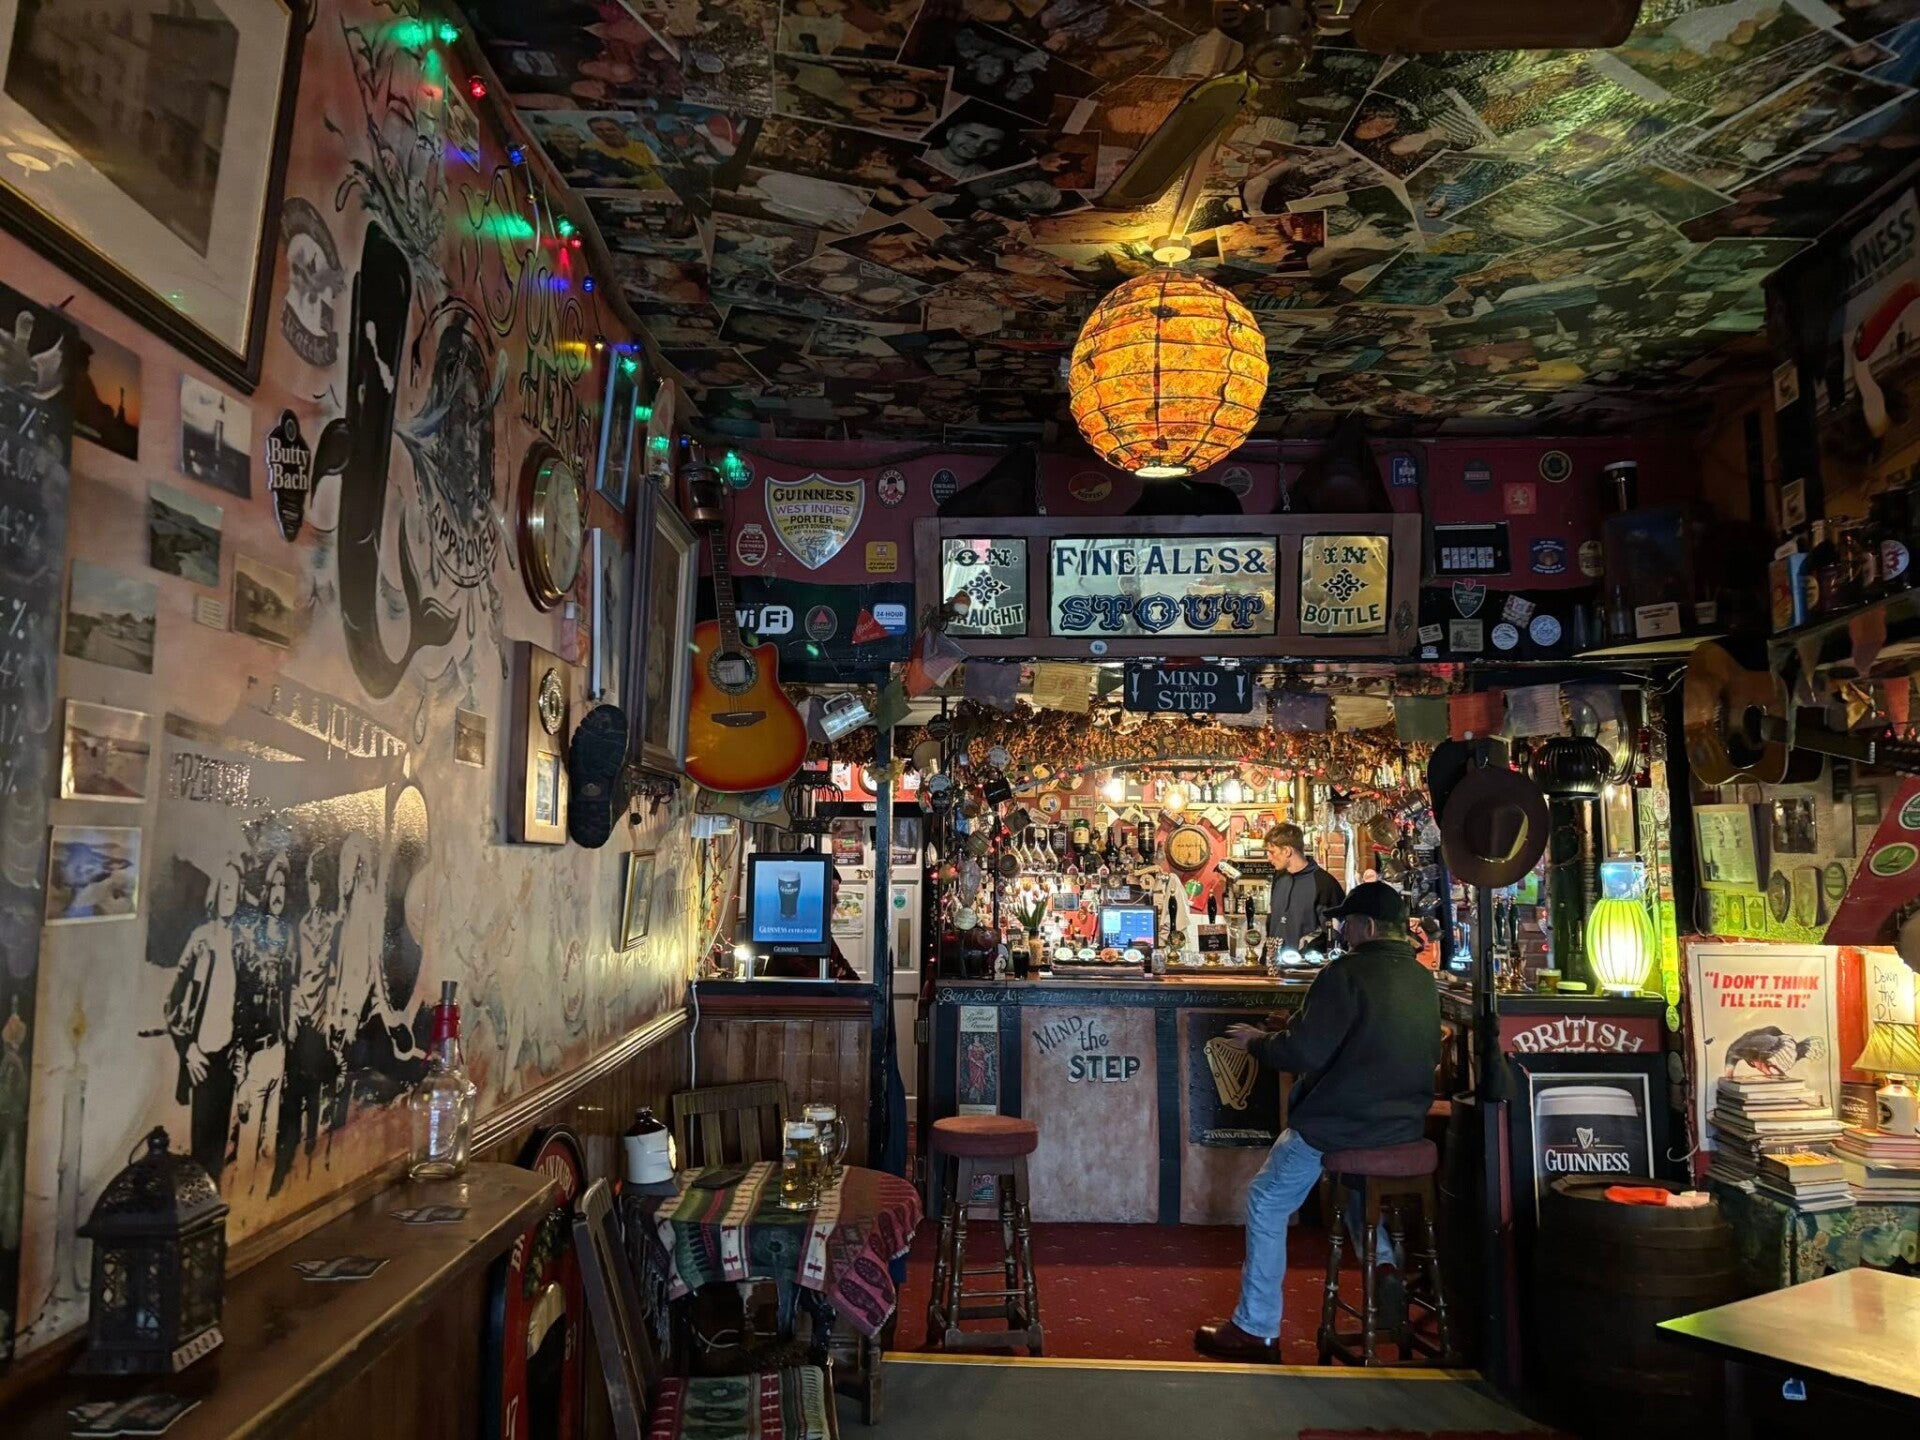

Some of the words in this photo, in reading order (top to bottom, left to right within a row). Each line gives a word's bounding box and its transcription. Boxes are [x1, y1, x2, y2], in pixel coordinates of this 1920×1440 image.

[270, 437, 309, 467] Butty
[272, 464, 308, 490] Bach
[773, 488, 854, 502] GUINNESS
[775, 504, 807, 515] WEST
[811, 505, 851, 515] INDIES
[790, 515, 833, 524] PORTER
[434, 502, 496, 570] APPROVED
[955, 547, 1012, 567] ON
[1056, 546, 1137, 576] FINE
[1324, 546, 1368, 565] IN
[1058, 591, 1265, 634] STOUT
[1303, 603, 1381, 625] BOTTLE
[1156, 670, 1218, 687] MIND
[1157, 689, 1217, 710] STEP
[759, 925, 787, 934] GUINNESS
[773, 945, 799, 953] GUINNESS
[1722, 974, 1768, 989] DON'T
[1773, 975, 1819, 990] THINK
[941, 987, 968, 1002] Ben's
[972, 989, 999, 1002] Real
[1720, 993, 1745, 1007] I'LL
[1749, 993, 1783, 1008] LIKE
[1032, 1015, 1082, 1054] MIND
[1078, 1020, 1109, 1051] the
[1512, 1015, 1644, 1052] BRITISH
[1067, 1055, 1140, 1083] STEP
[1545, 1149, 1629, 1172] GUINNESS
